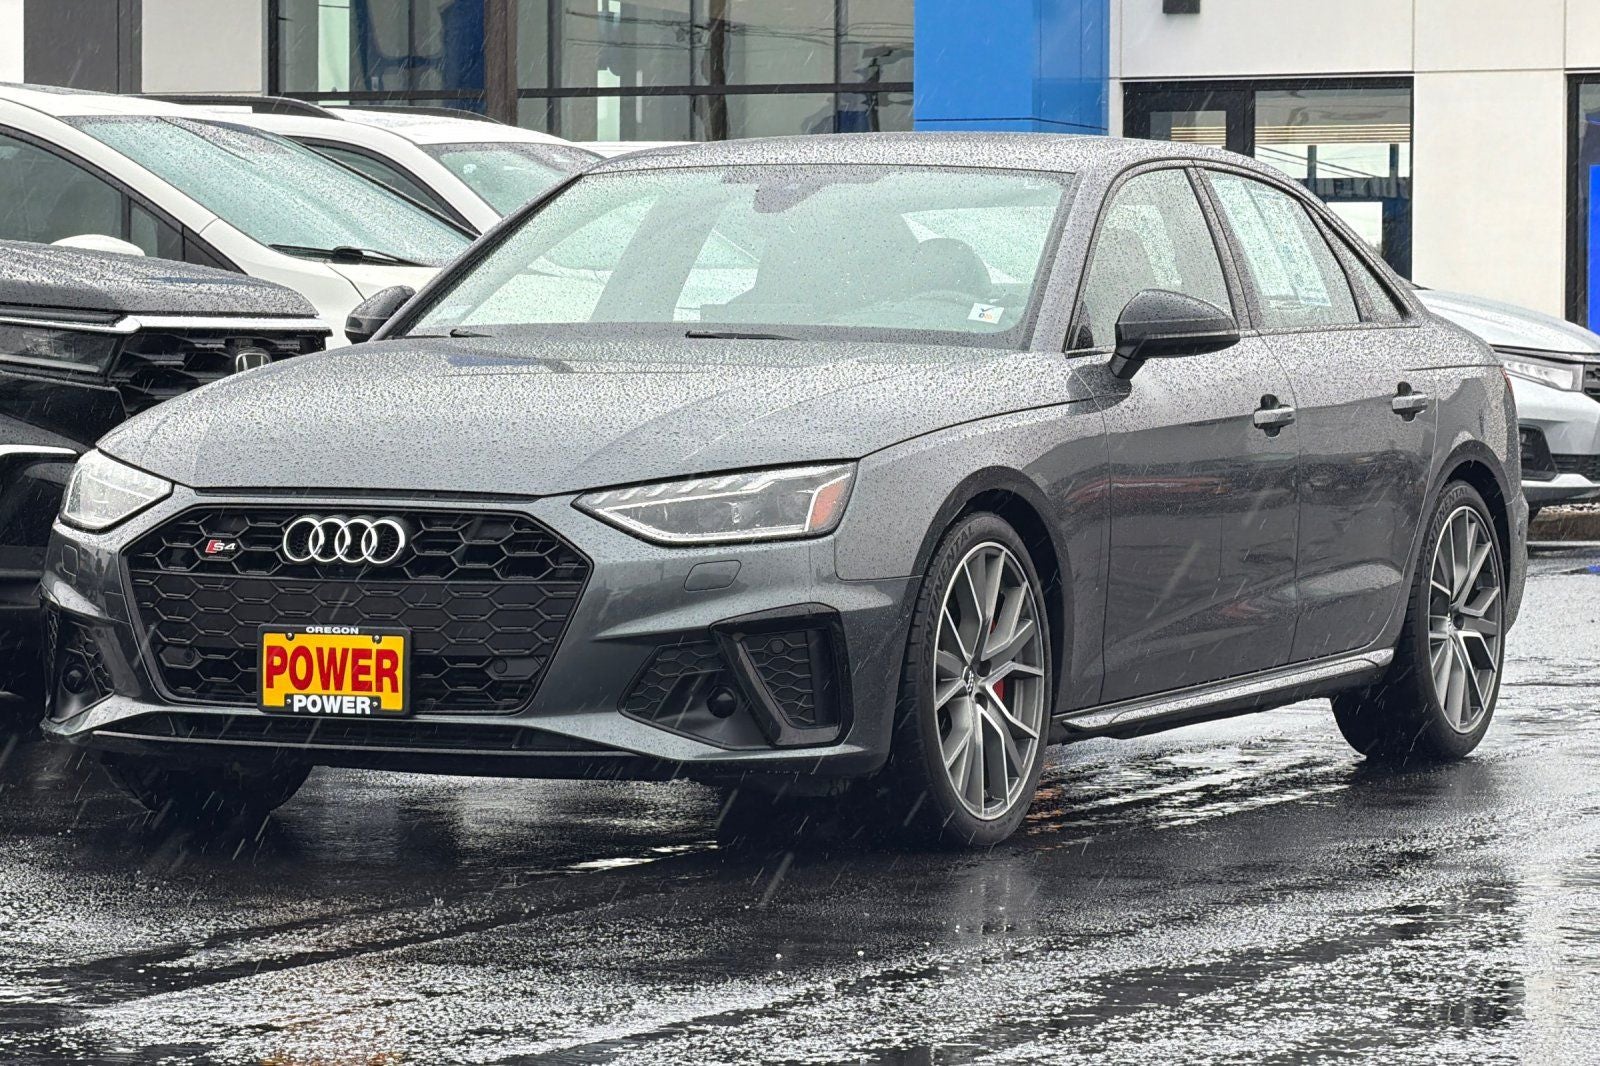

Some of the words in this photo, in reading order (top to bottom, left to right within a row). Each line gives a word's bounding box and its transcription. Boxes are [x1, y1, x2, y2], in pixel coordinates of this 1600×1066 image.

[212, 542, 236, 551] S4
[305, 626, 360, 635] OREGON
[265, 645, 400, 693] POWER
[293, 694, 372, 715] POWER
